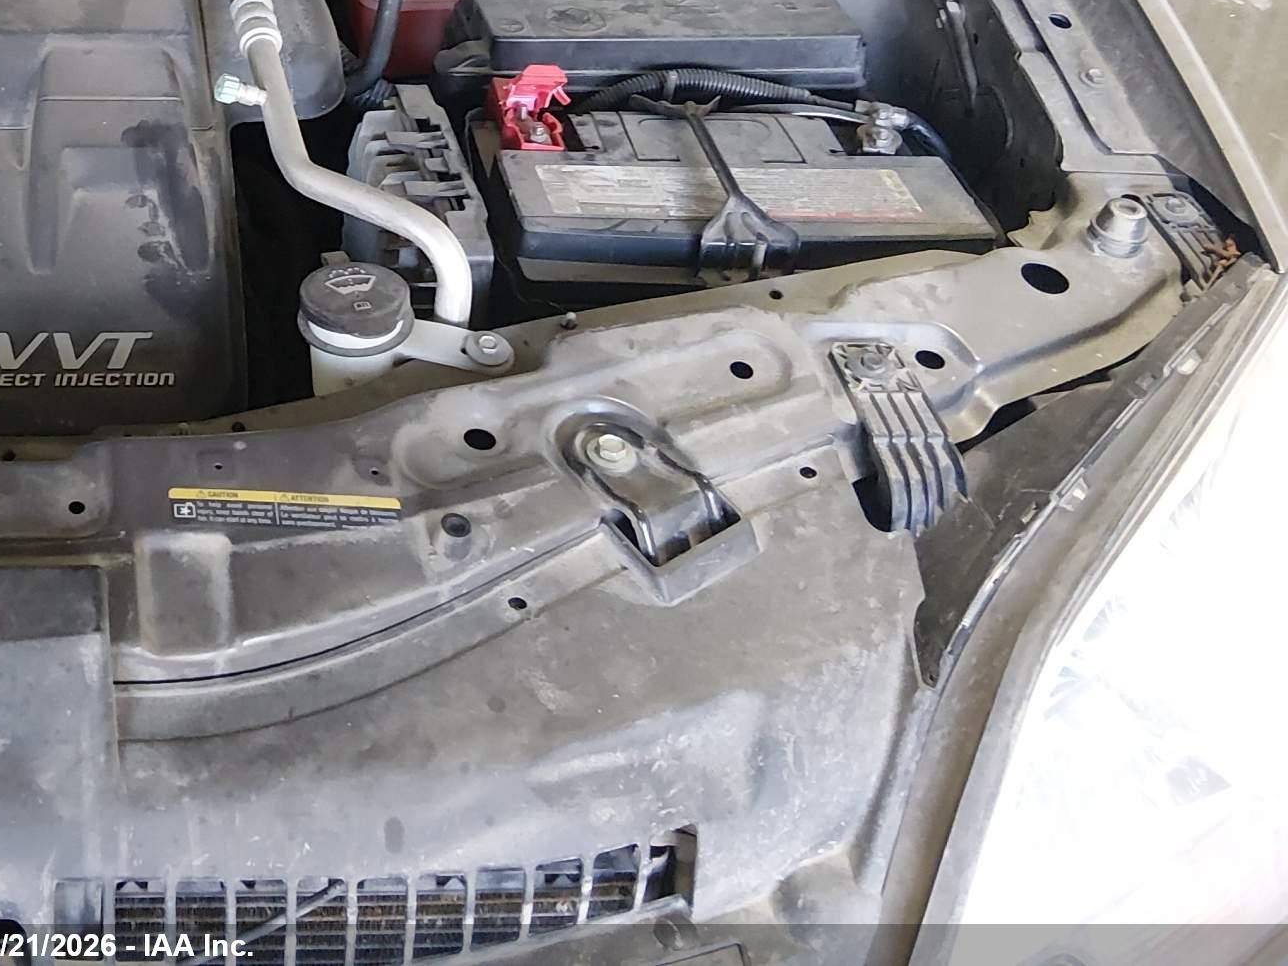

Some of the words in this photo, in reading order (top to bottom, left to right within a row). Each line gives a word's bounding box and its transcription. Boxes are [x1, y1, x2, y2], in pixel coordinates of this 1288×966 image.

[54, 371, 176, 387] INJECTION
[206, 490, 239, 499] CAUTION
[290, 494, 330, 503] ATTENTION
